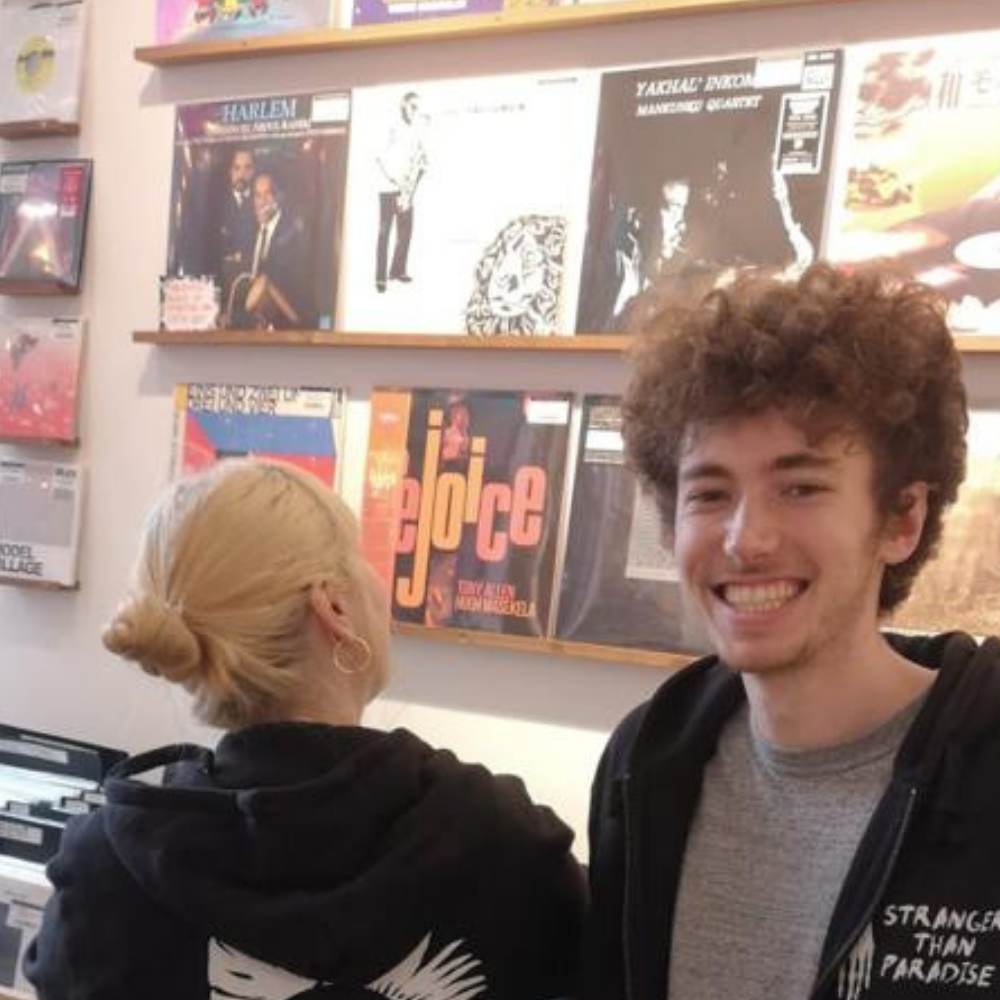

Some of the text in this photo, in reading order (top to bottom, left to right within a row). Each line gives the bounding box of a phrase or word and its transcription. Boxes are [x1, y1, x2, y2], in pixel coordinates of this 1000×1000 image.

[223, 98, 297, 123] HARLEM
[394, 408, 547, 608] ejoice
[913, 932, 976, 957] THAN
[880, 954, 996, 987] PARADISE
